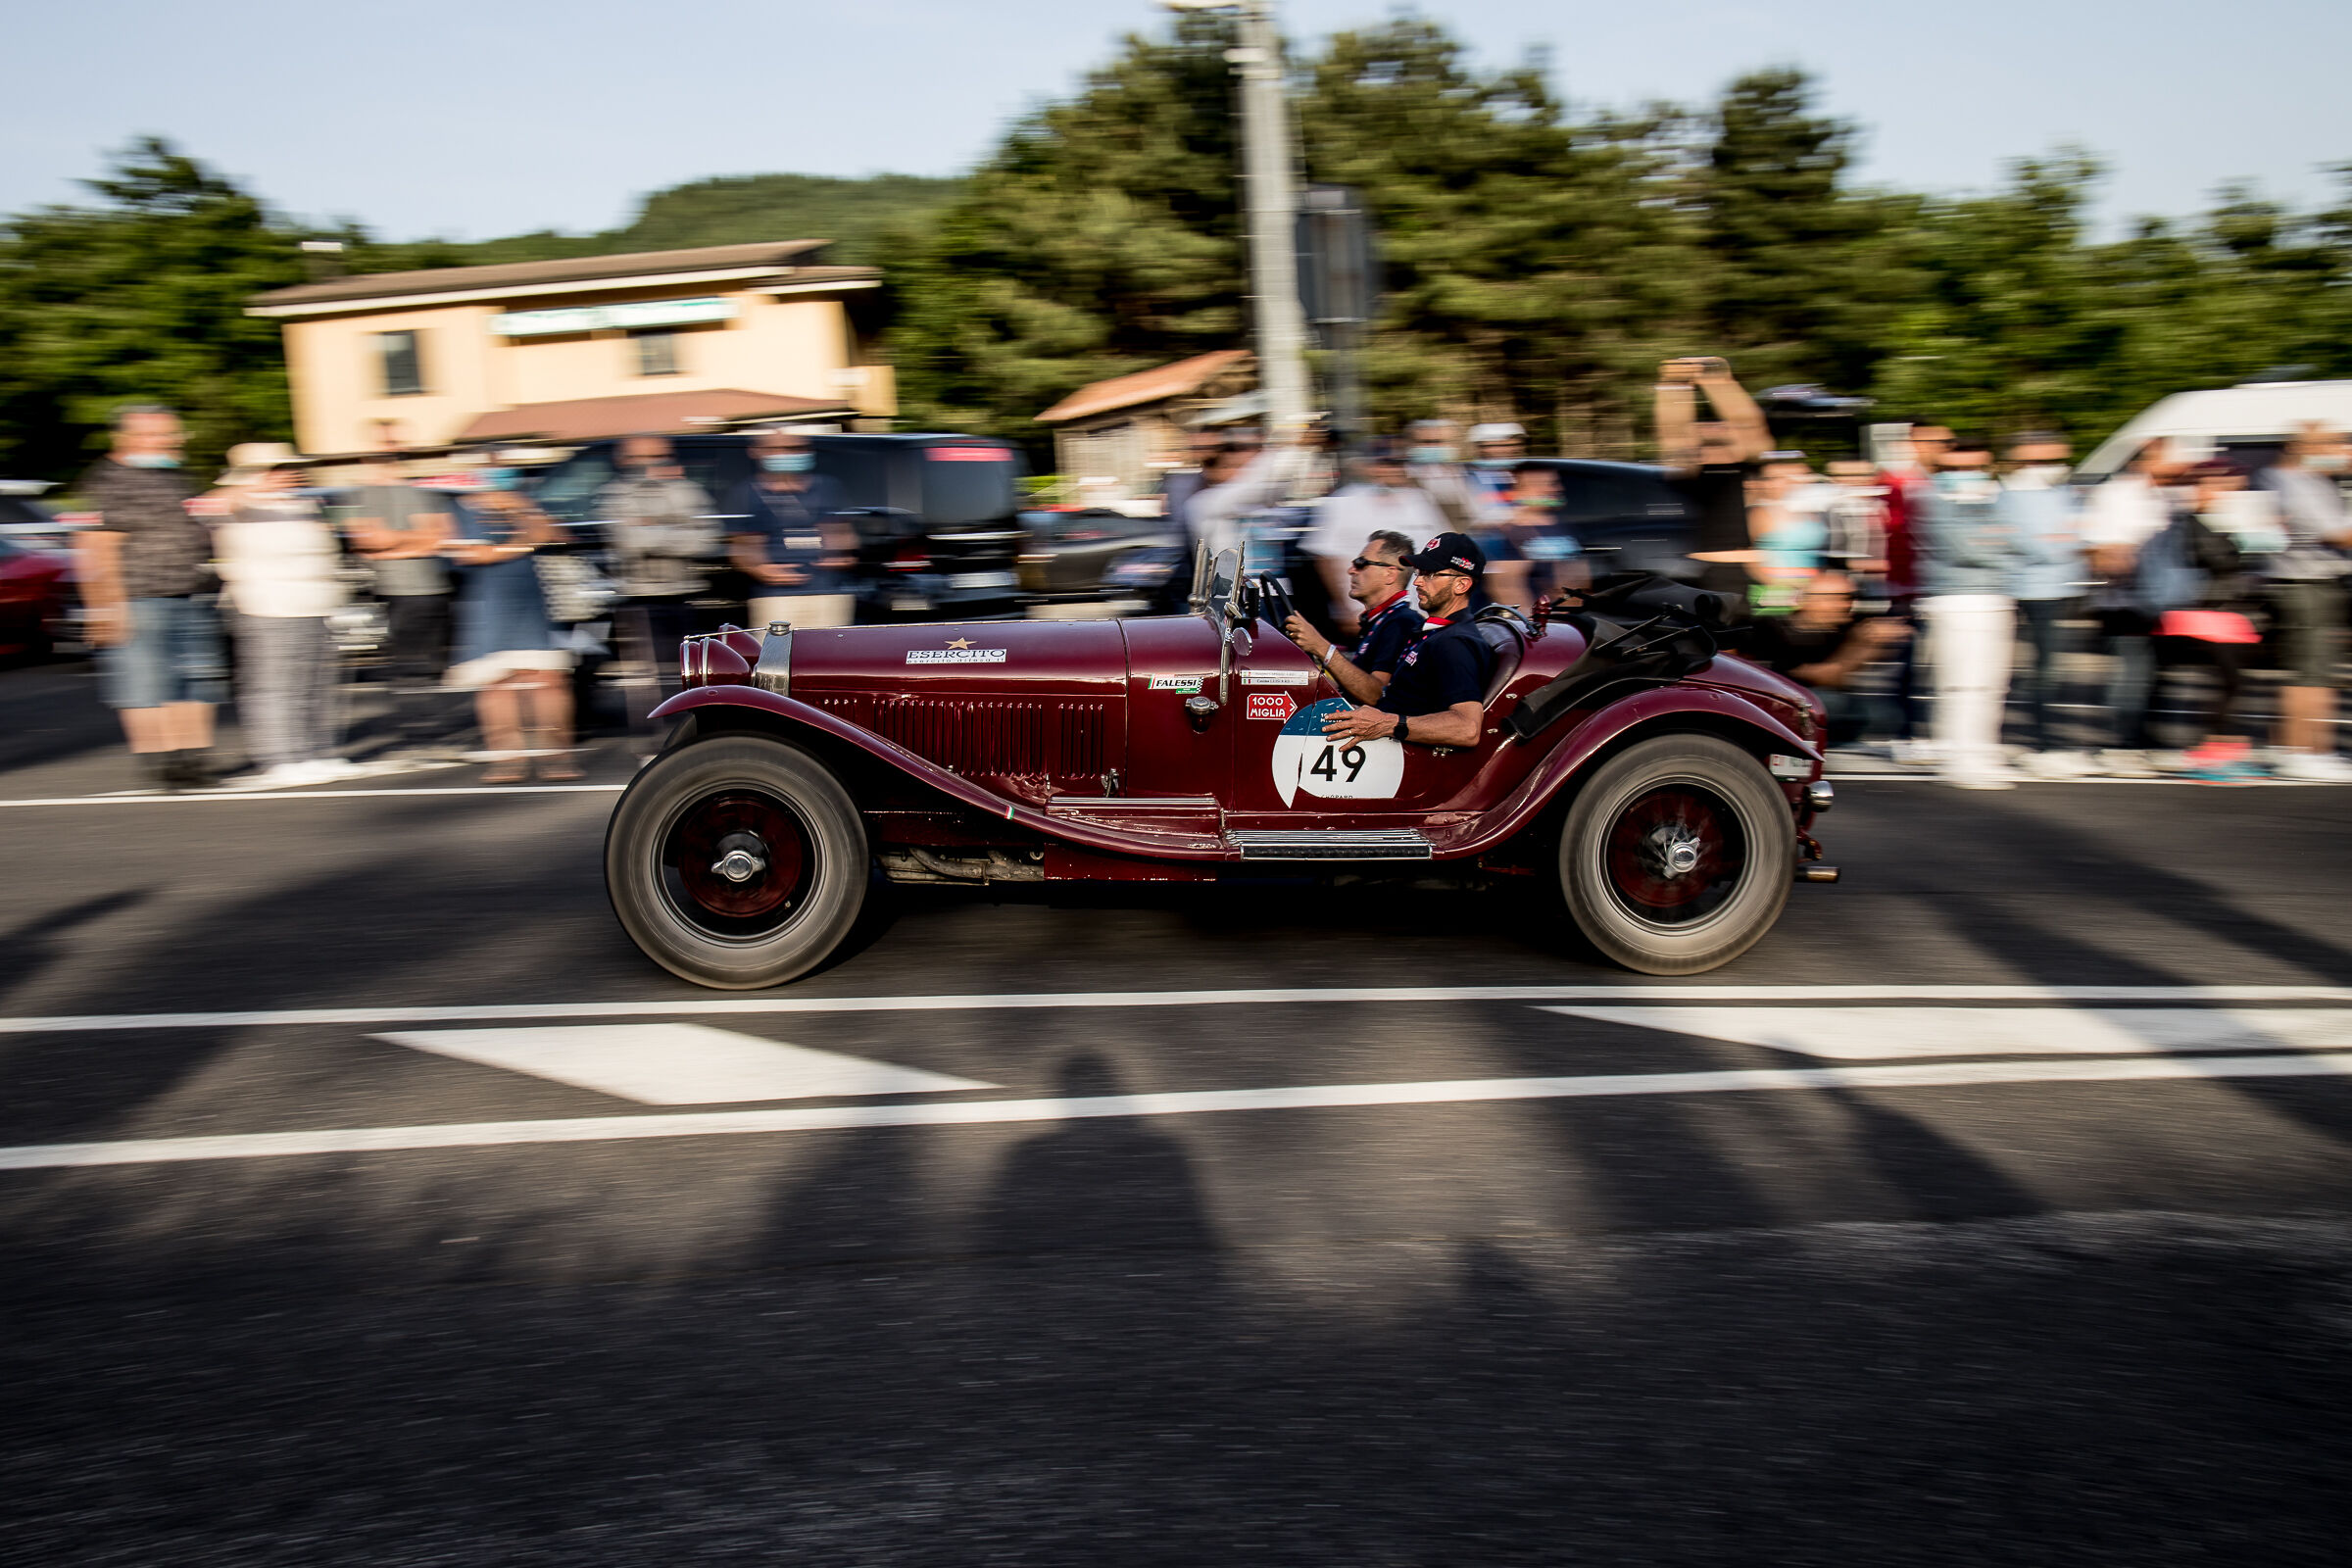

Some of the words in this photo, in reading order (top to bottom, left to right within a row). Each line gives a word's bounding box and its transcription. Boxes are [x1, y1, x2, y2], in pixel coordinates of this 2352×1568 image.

[907, 649, 1005, 659] ESERCITO
[1252, 696, 1284, 706] 1000
[1250, 708, 1286, 717] MIGLIA
[1310, 745, 1366, 782] 49
